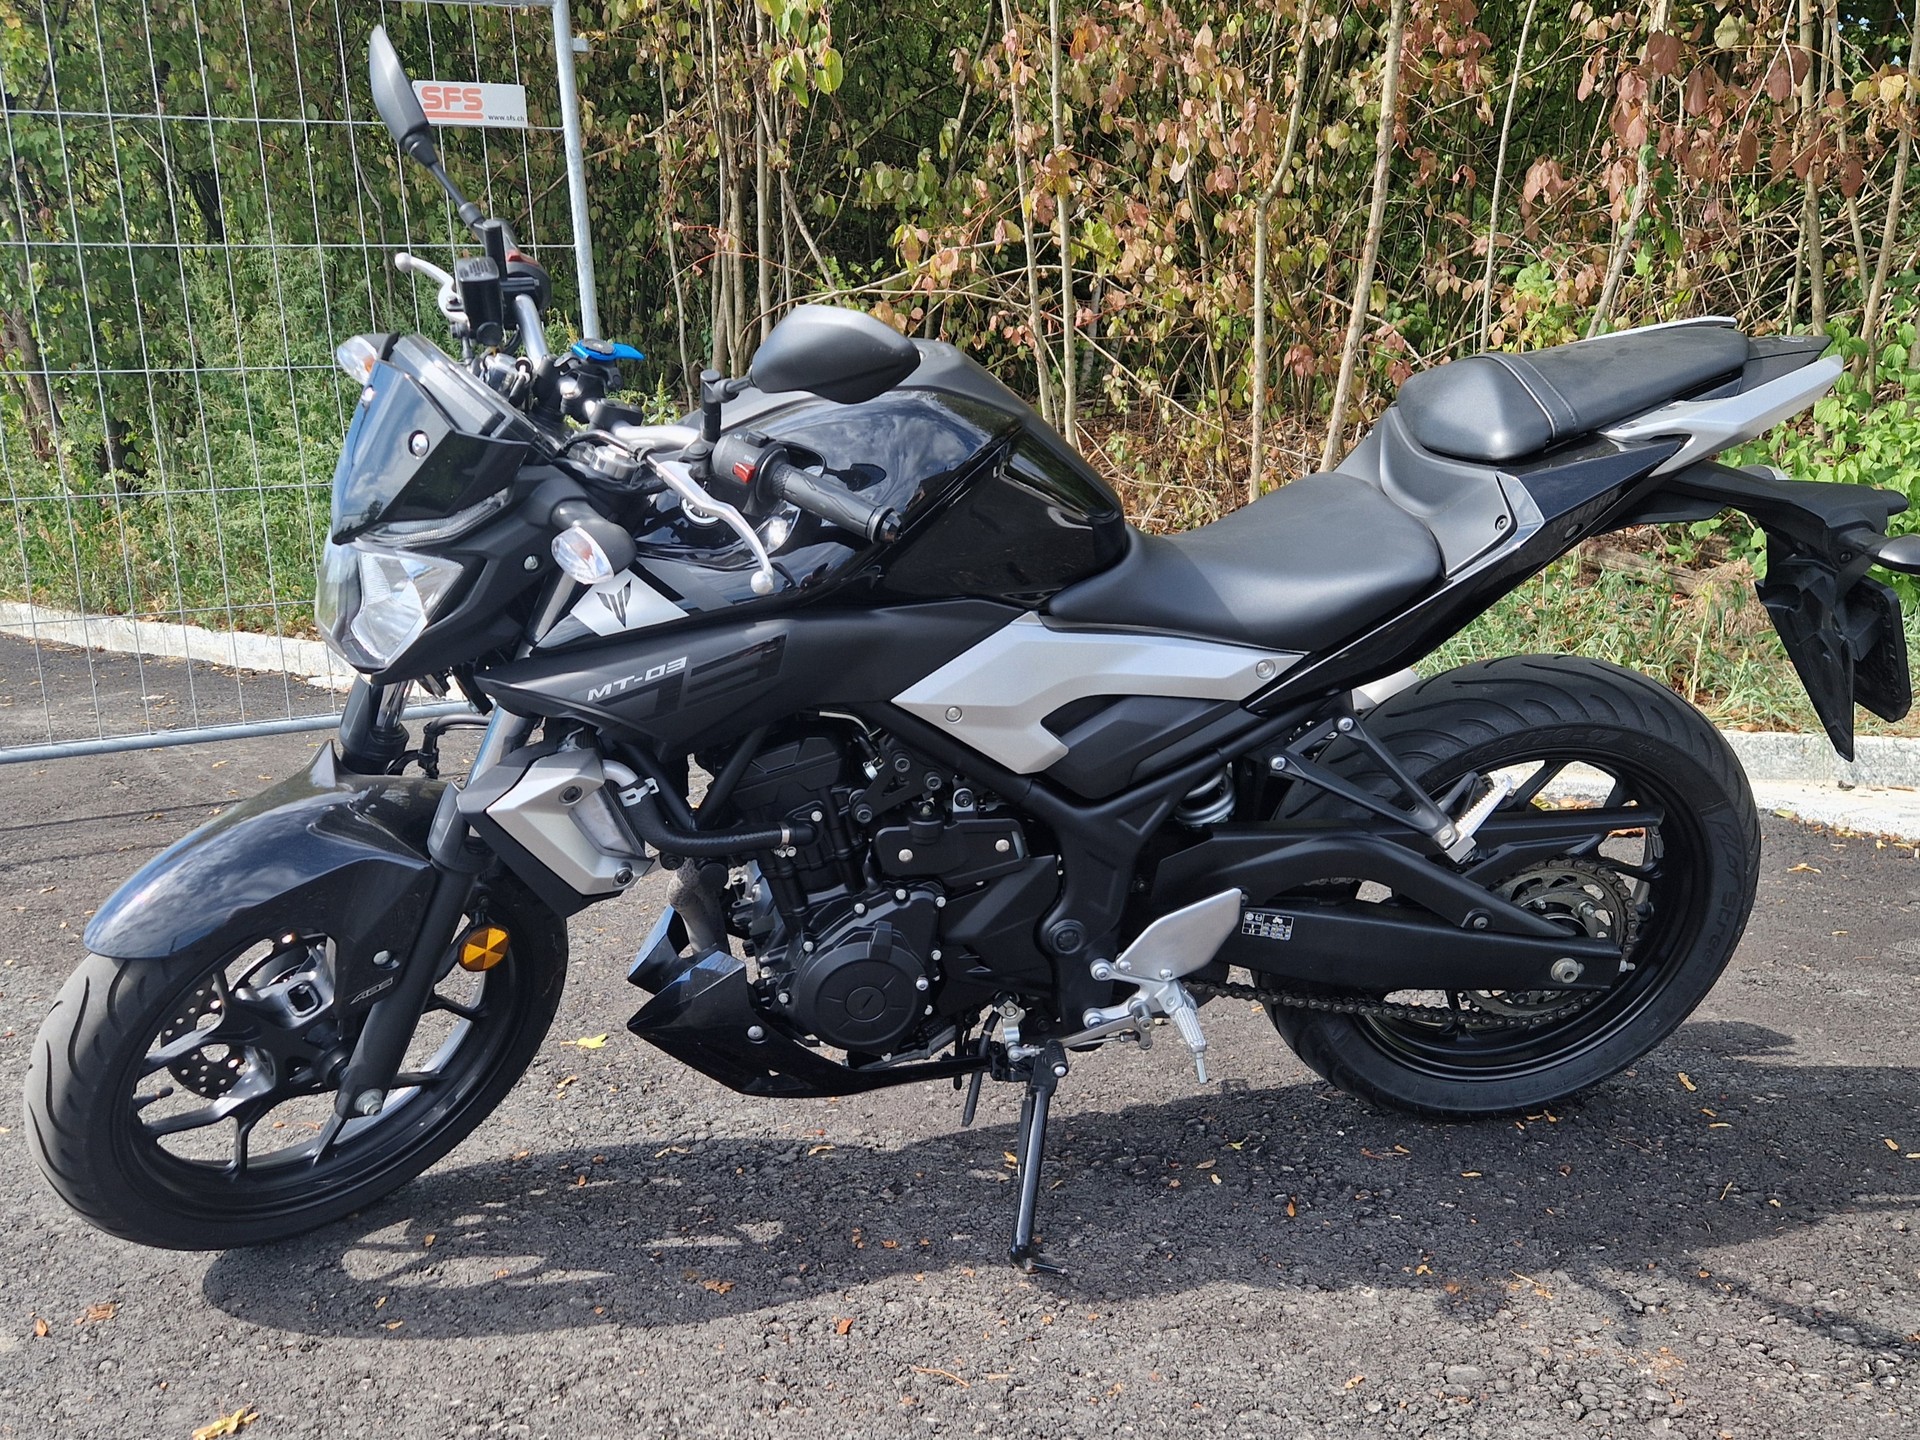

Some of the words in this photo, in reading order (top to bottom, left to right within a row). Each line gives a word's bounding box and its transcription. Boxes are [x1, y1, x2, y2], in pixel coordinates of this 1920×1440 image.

[421, 86, 483, 111] SFS
[488, 114, 525, 122] www.sfs.ch
[587, 656, 688, 702] MT-03
